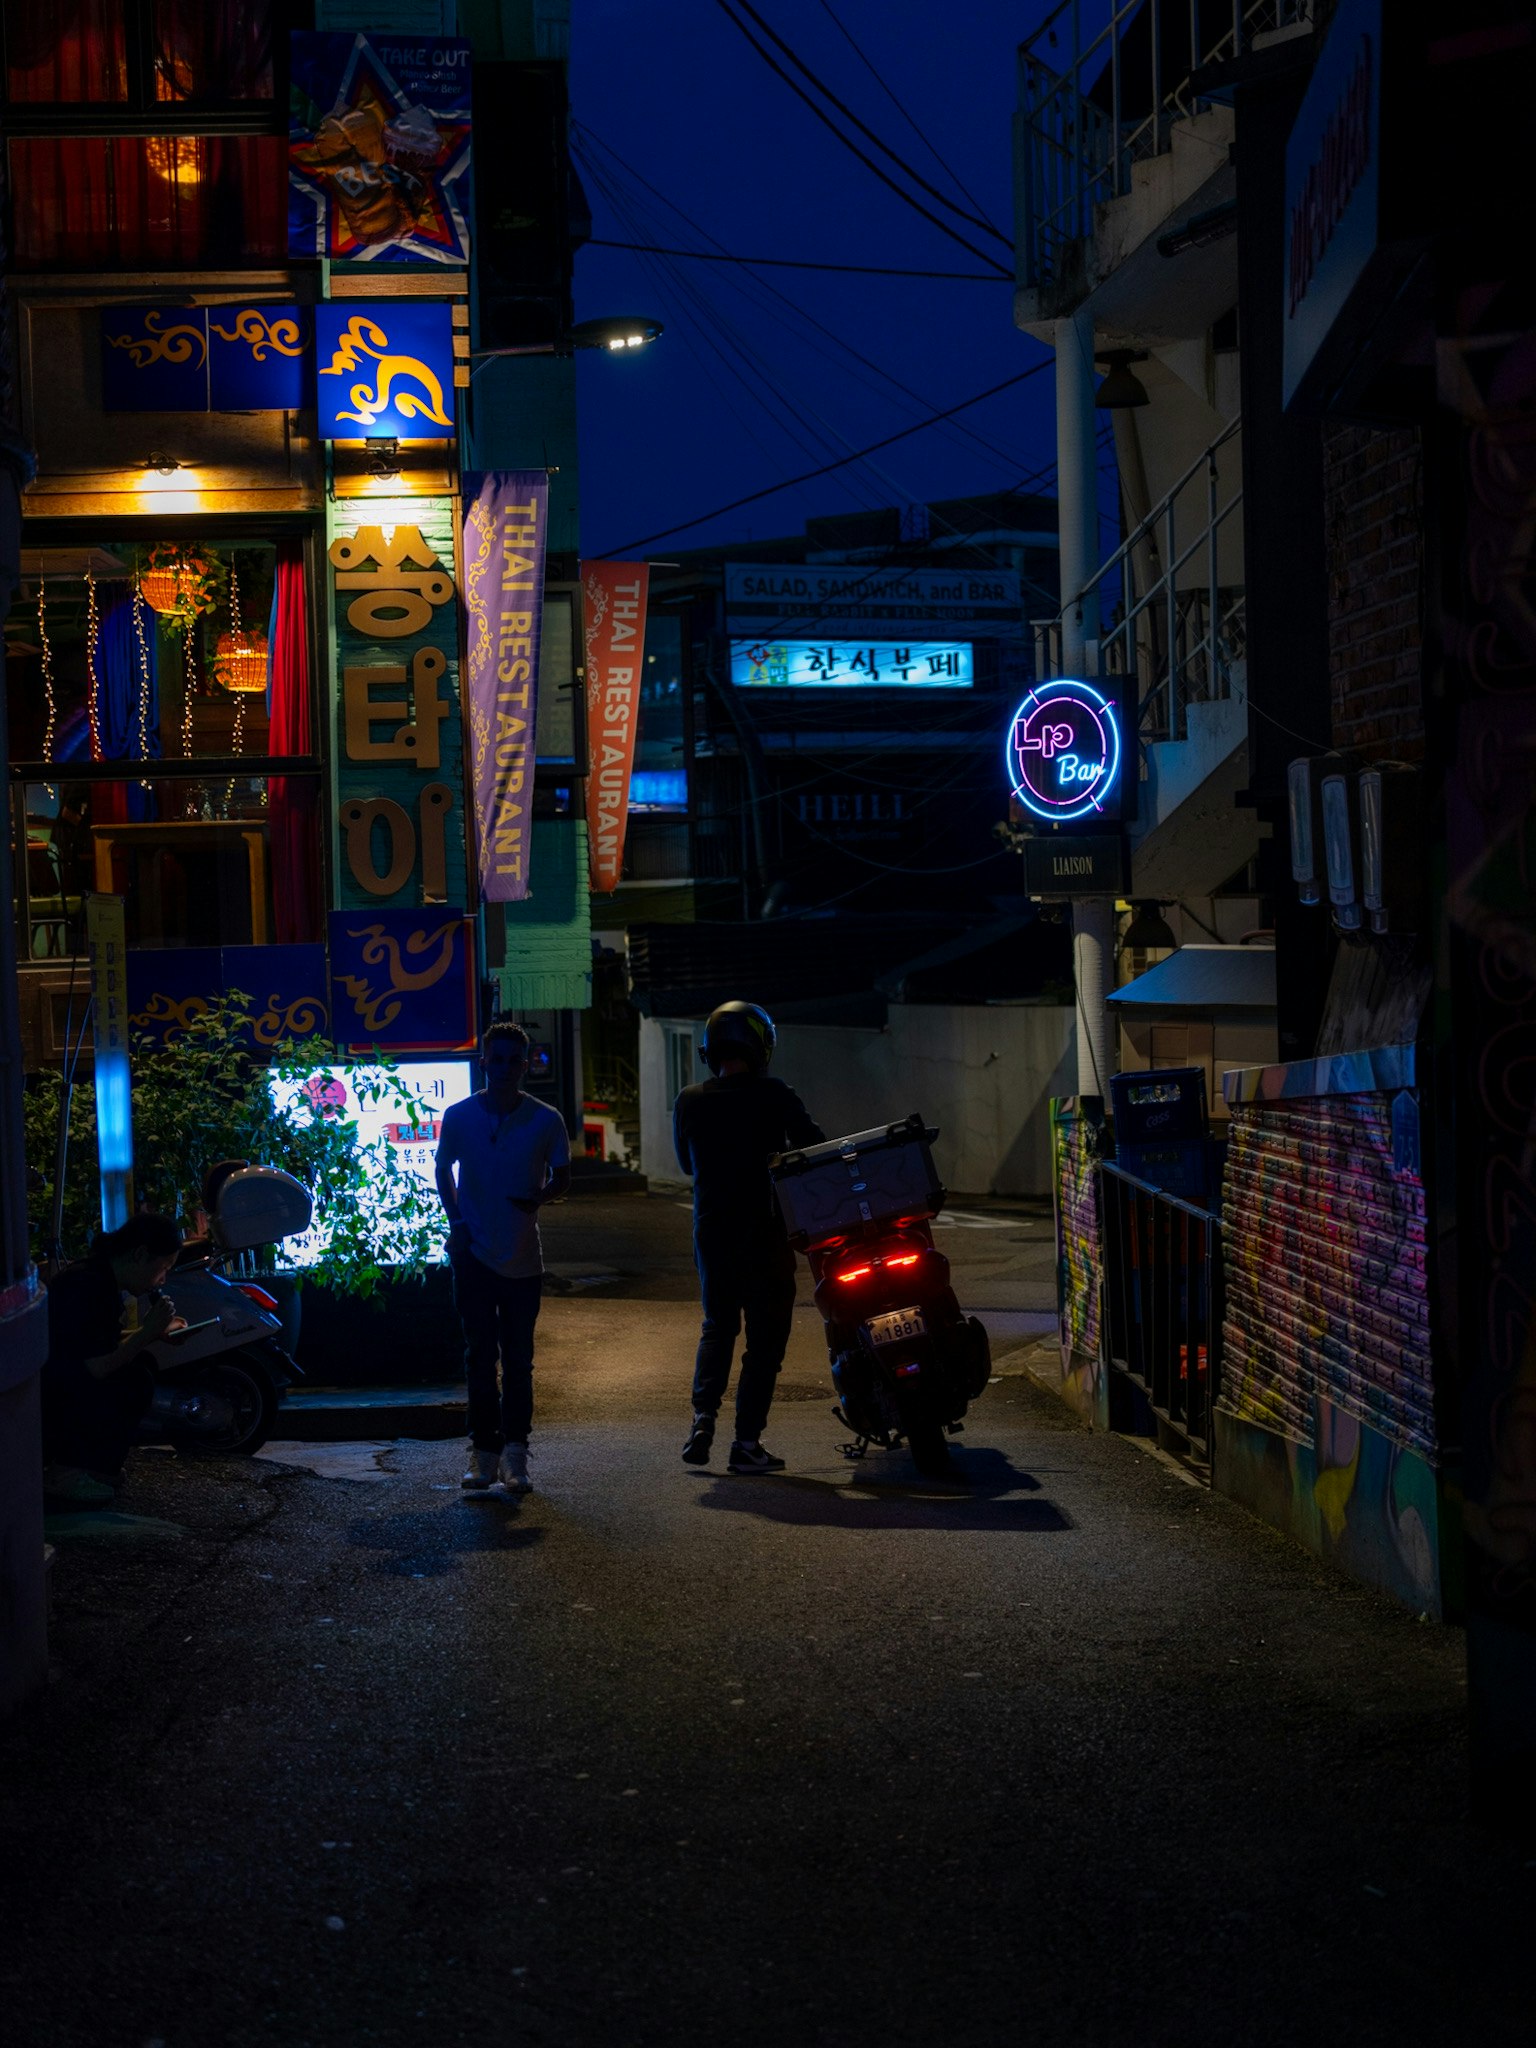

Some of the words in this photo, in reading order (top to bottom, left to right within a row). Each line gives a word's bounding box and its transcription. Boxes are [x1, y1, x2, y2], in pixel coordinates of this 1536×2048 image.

[379, 47, 427, 65] TAKE
[432, 48, 471, 68] OUT
[440, 82, 462, 94] Beer
[502, 497, 537, 591] THAI
[743, 577, 812, 600] SALAD,
[816, 578, 926, 602] SANDWICH,
[930, 583, 964, 601] and
[968, 583, 1005, 602] BAR
[610, 579, 641, 653] THAI
[805, 646, 960, 682] 한식부페
[495, 610, 533, 881] RESTAURANT
[597, 666, 632, 878] RESTAURANT
[1056, 753, 1107, 785] Bar
[1052, 856, 1094, 876] LIAISON
[885, 1319, 920, 1340] 1881
